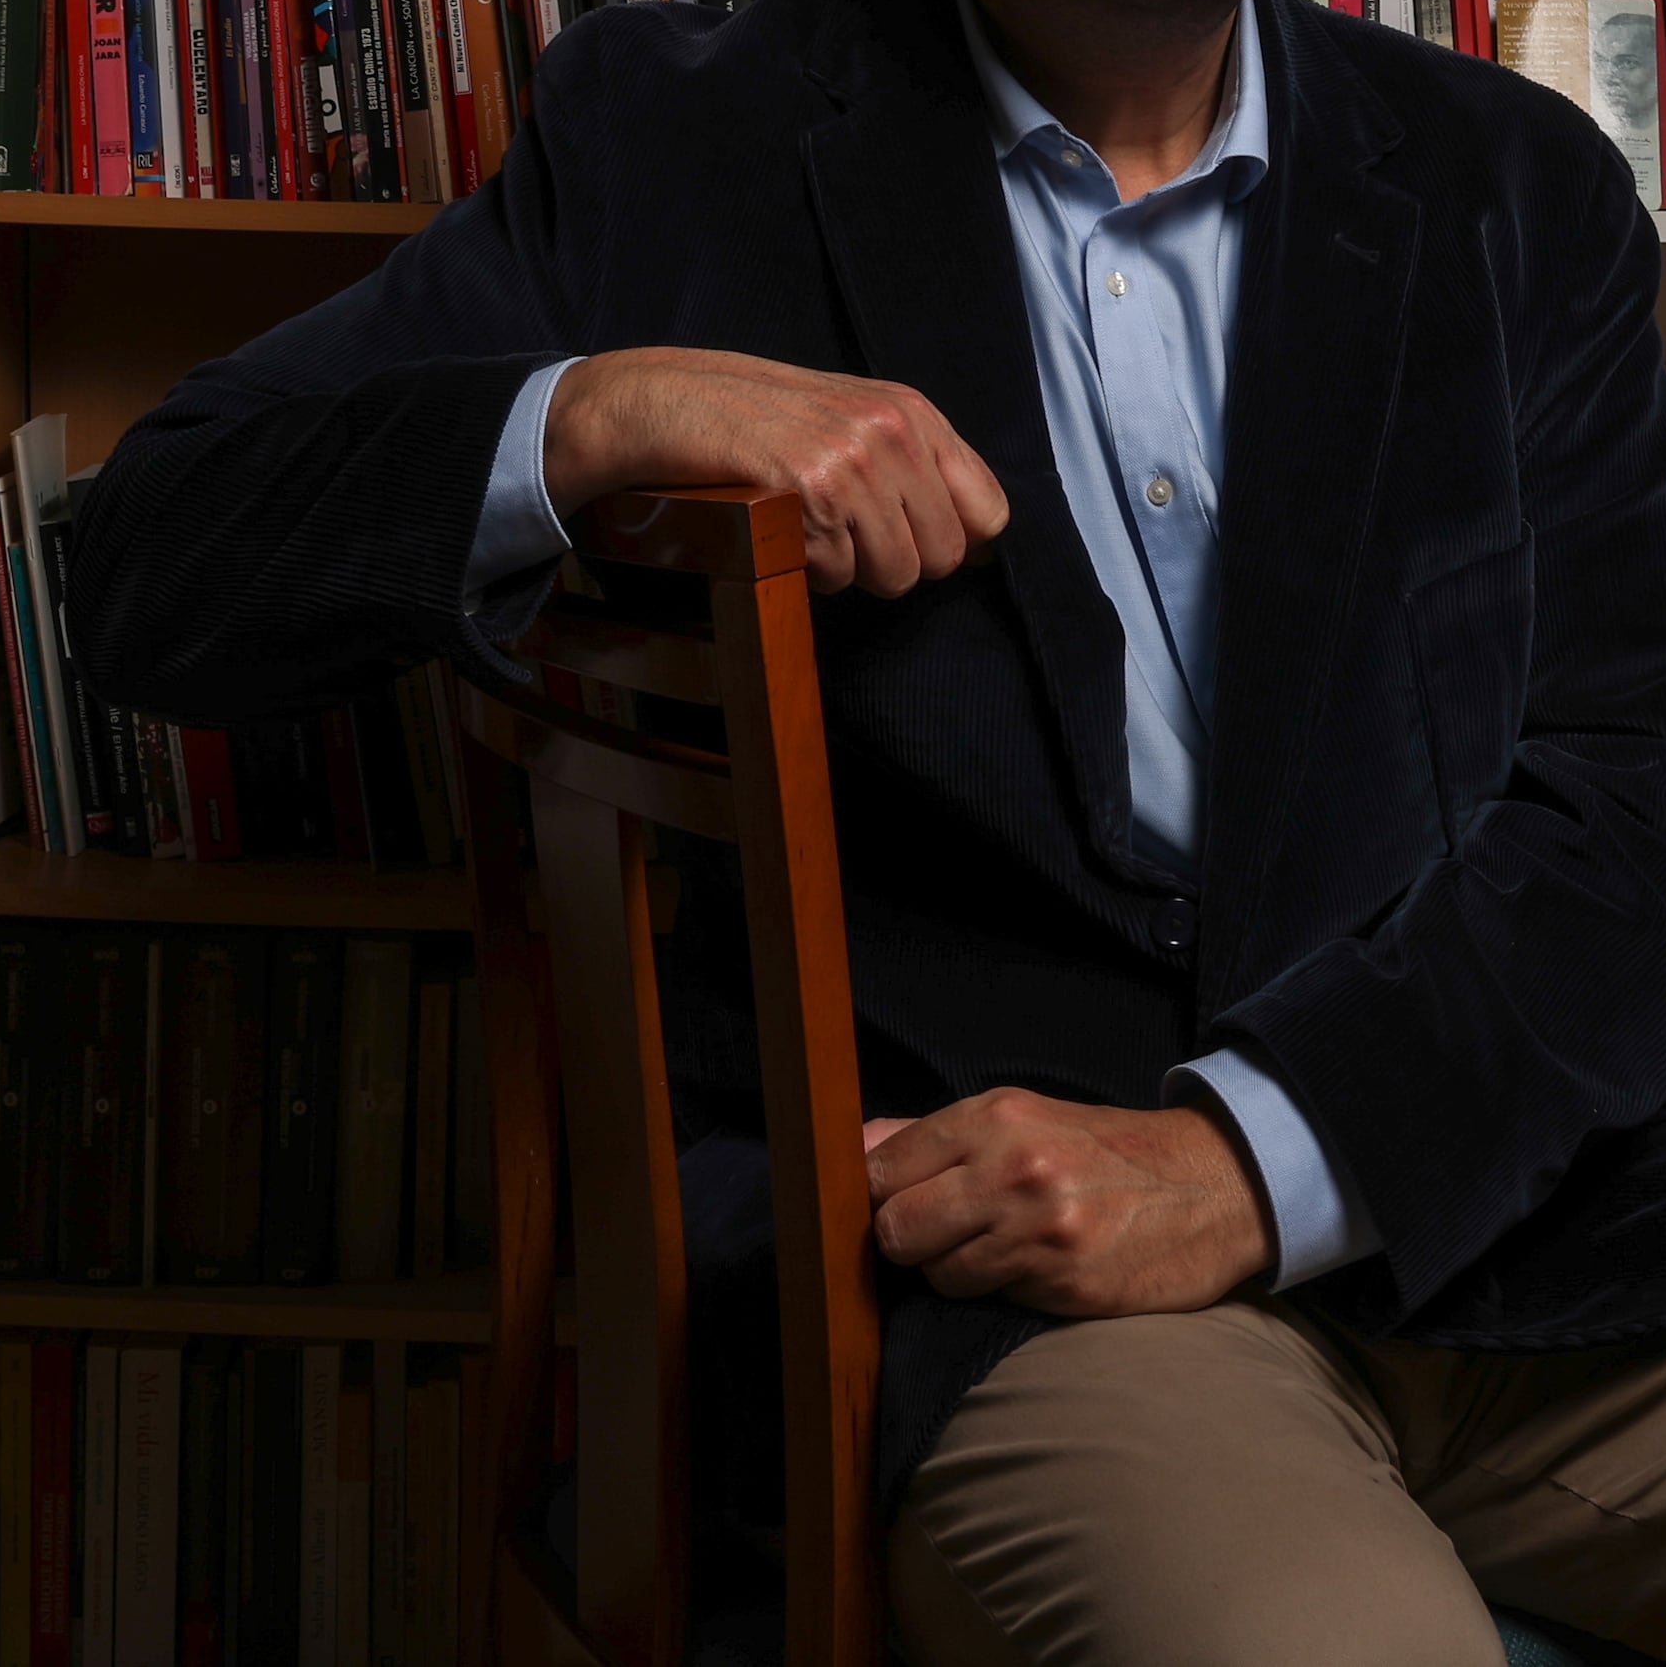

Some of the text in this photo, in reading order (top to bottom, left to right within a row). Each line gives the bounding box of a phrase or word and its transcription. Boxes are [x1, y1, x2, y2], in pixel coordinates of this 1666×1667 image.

[94, 38, 121, 47] JOAN
[95, 51, 121, 60] JARA
[193, 27, 208, 118] QUELENTARO
